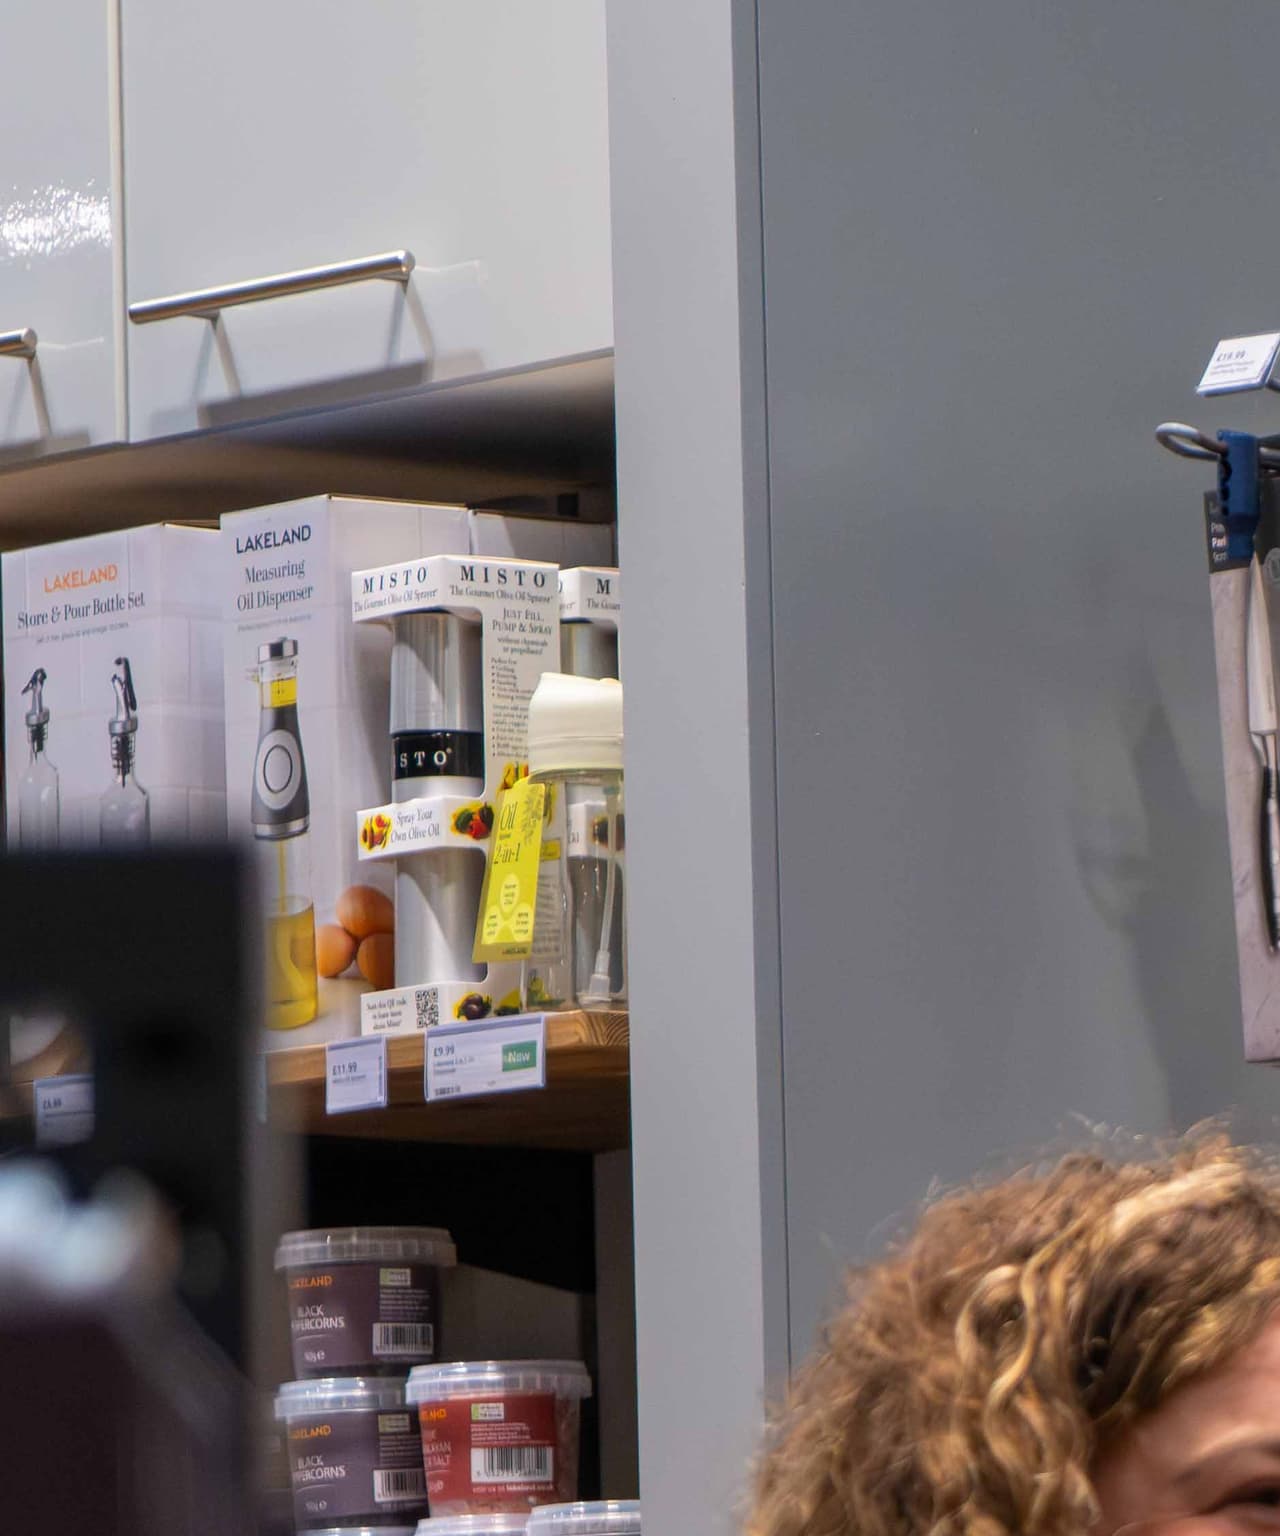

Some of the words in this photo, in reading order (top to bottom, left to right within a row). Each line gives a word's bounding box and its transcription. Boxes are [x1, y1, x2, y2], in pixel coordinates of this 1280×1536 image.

[236, 524, 311, 554] LAKELAND
[44, 563, 118, 593] LAKELAND
[245, 559, 306, 584] Measuring
[362, 566, 428, 594] MISTO
[460, 565, 546, 589] MISTO
[237, 593, 254, 612] Oil
[257, 585, 314, 610] Dispenser
[363, 596, 387, 612] Gourmet
[387, 592, 403, 607] Olive
[450, 584, 463, 597] The
[465, 586, 495, 599] Gourmet
[496, 588, 515, 601] Olive
[516, 589, 526, 601] Oil
[17, 609, 49, 631] Store
[51, 605, 61, 624] &
[64, 602, 89, 621] Pour
[93, 596, 125, 616] Bottle
[127, 591, 145, 608] Set
[503, 607, 521, 620] JUST
[492, 619, 517, 633] PUMP
[518, 622, 526, 633] &
[528, 623, 553, 635] SPRAY
[396, 810, 415, 826] Spray
[416, 807, 433, 821] Your
[500, 801, 518, 829] Oil
[390, 829, 407, 842] Own
[408, 826, 426, 840] Olive
[427, 824, 440, 837] Oil
[506, 1049, 530, 1064] New
